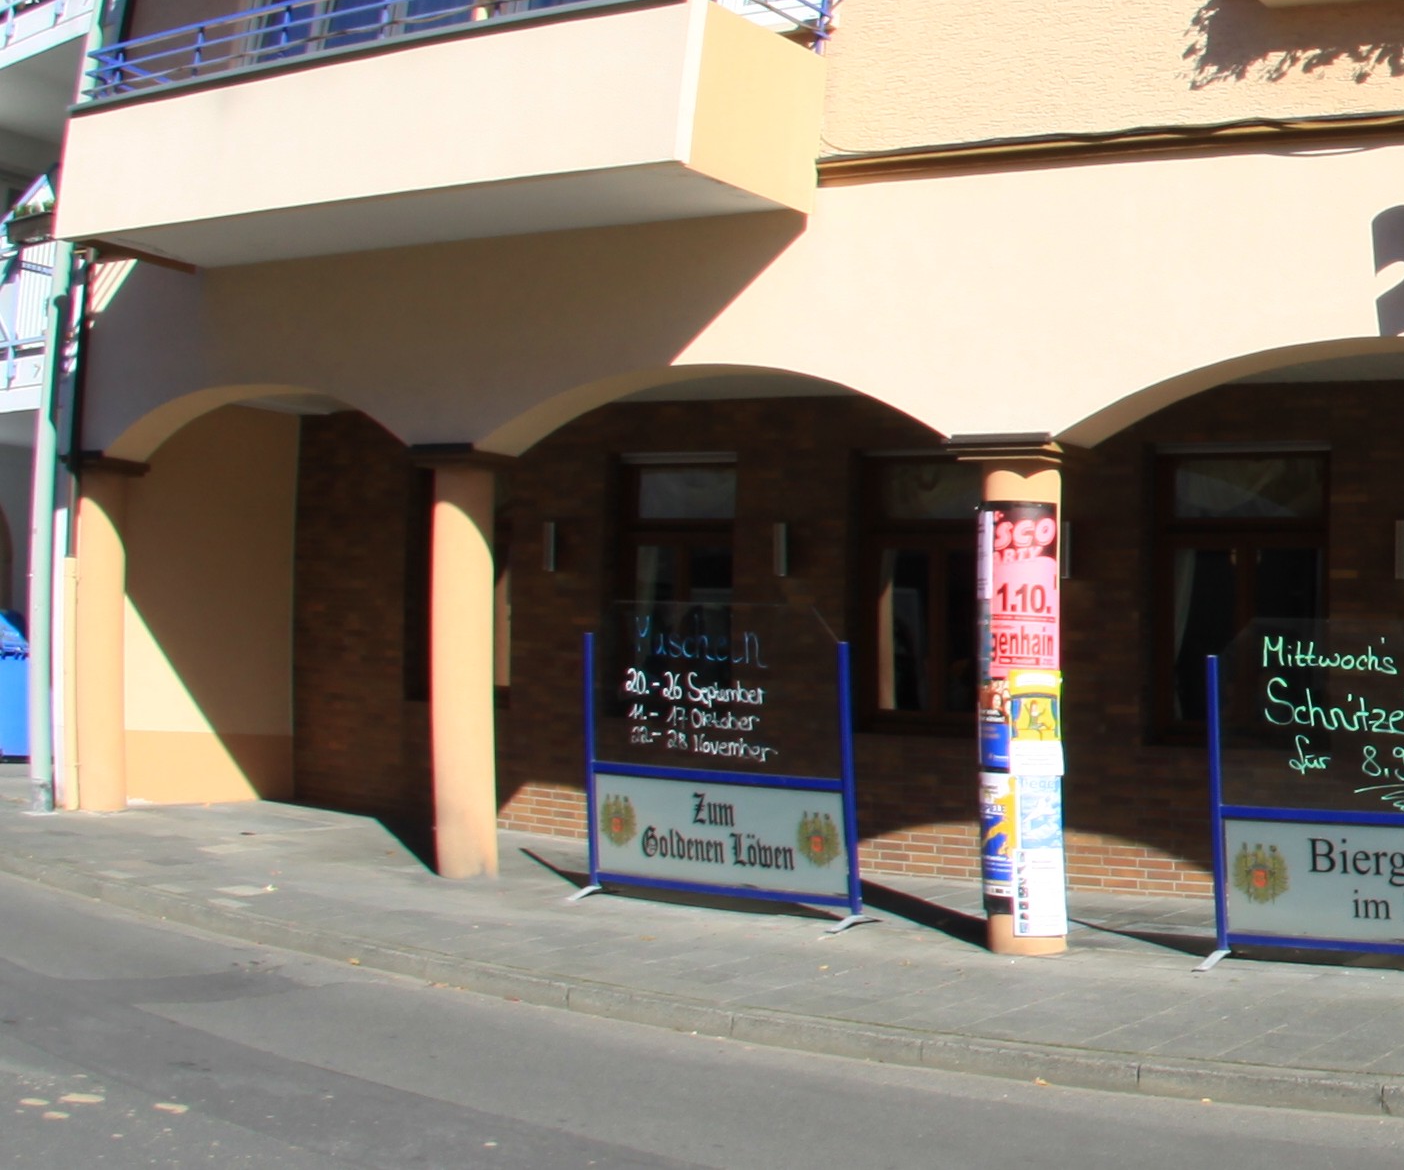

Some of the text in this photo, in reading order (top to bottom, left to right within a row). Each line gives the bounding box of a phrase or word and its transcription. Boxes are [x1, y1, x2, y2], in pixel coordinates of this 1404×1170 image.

[991, 626, 1054, 662] genhain
[687, 671, 767, 707] September
[692, 791, 736, 827] Zum
[642, 825, 795, 871] Goldenen Löwen
[1352, 889, 1391, 920] im
